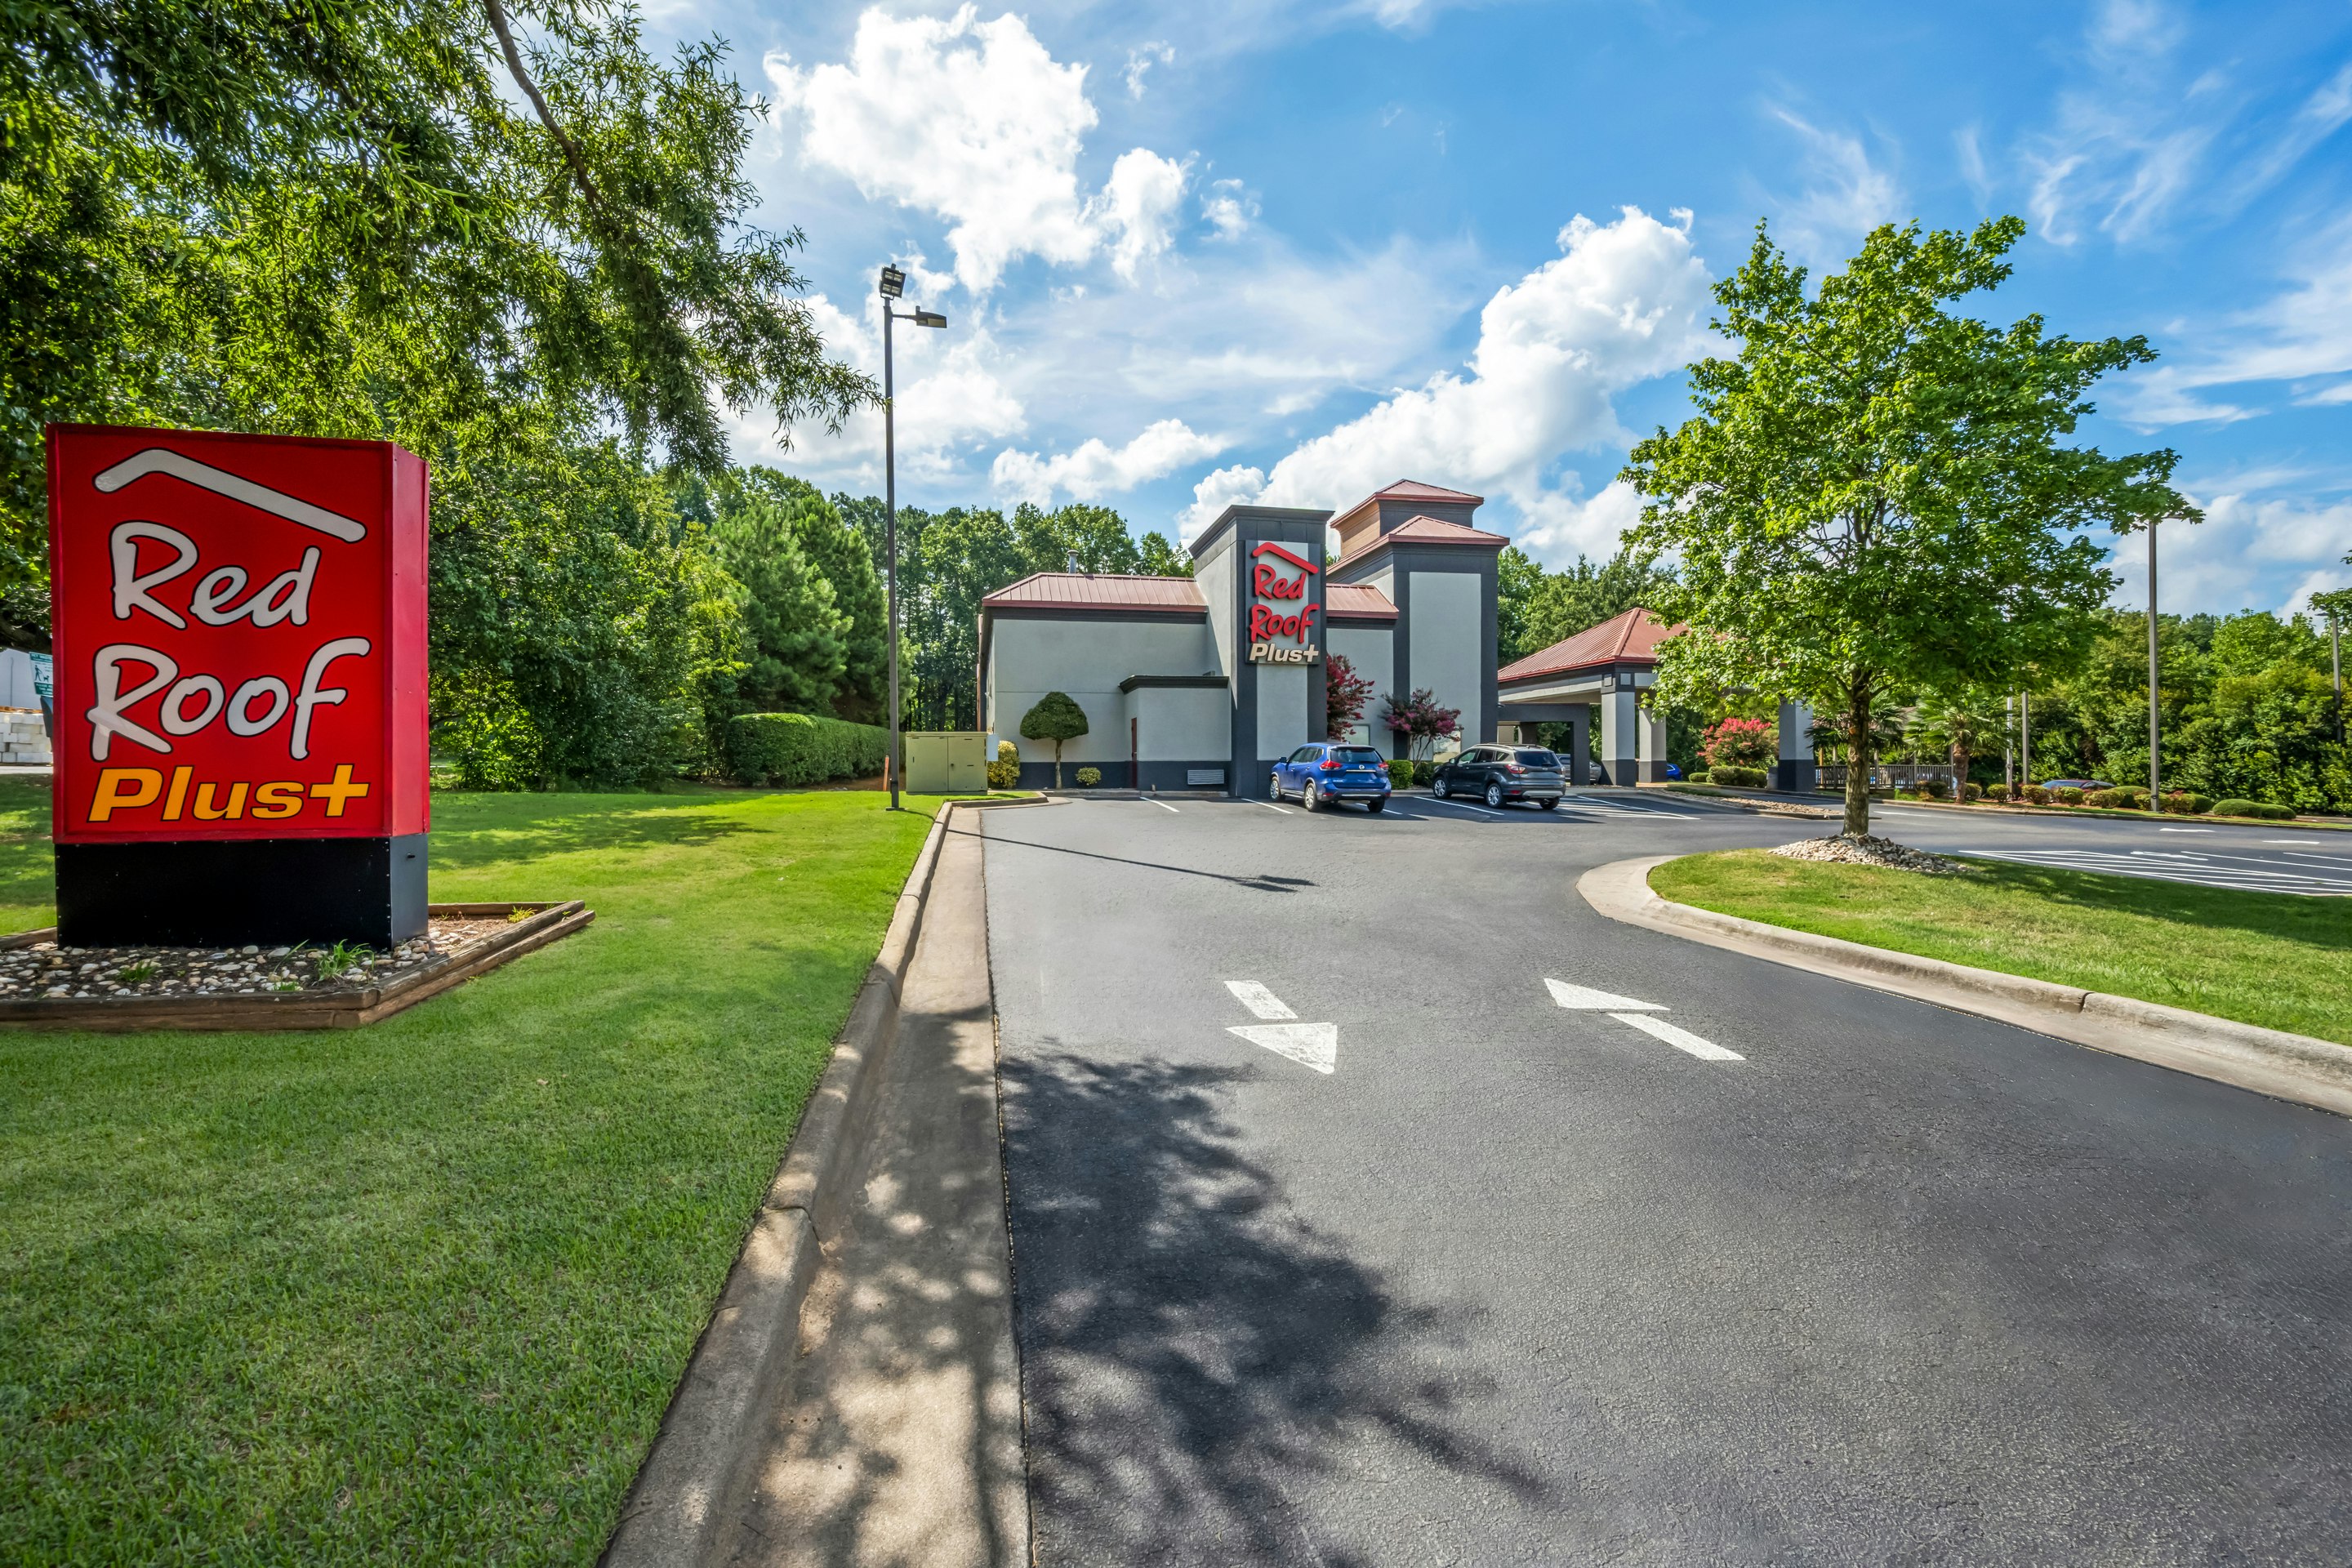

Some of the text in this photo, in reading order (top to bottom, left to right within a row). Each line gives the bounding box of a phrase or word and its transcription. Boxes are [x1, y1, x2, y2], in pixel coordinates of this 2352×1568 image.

[110, 521, 321, 630] Red
[1254, 564, 1307, 599] Red
[1250, 604, 1321, 644] Roof
[1250, 643, 1319, 662] Plus+
[87, 638, 371, 760] Roof
[89, 764, 369, 822] Plus+
